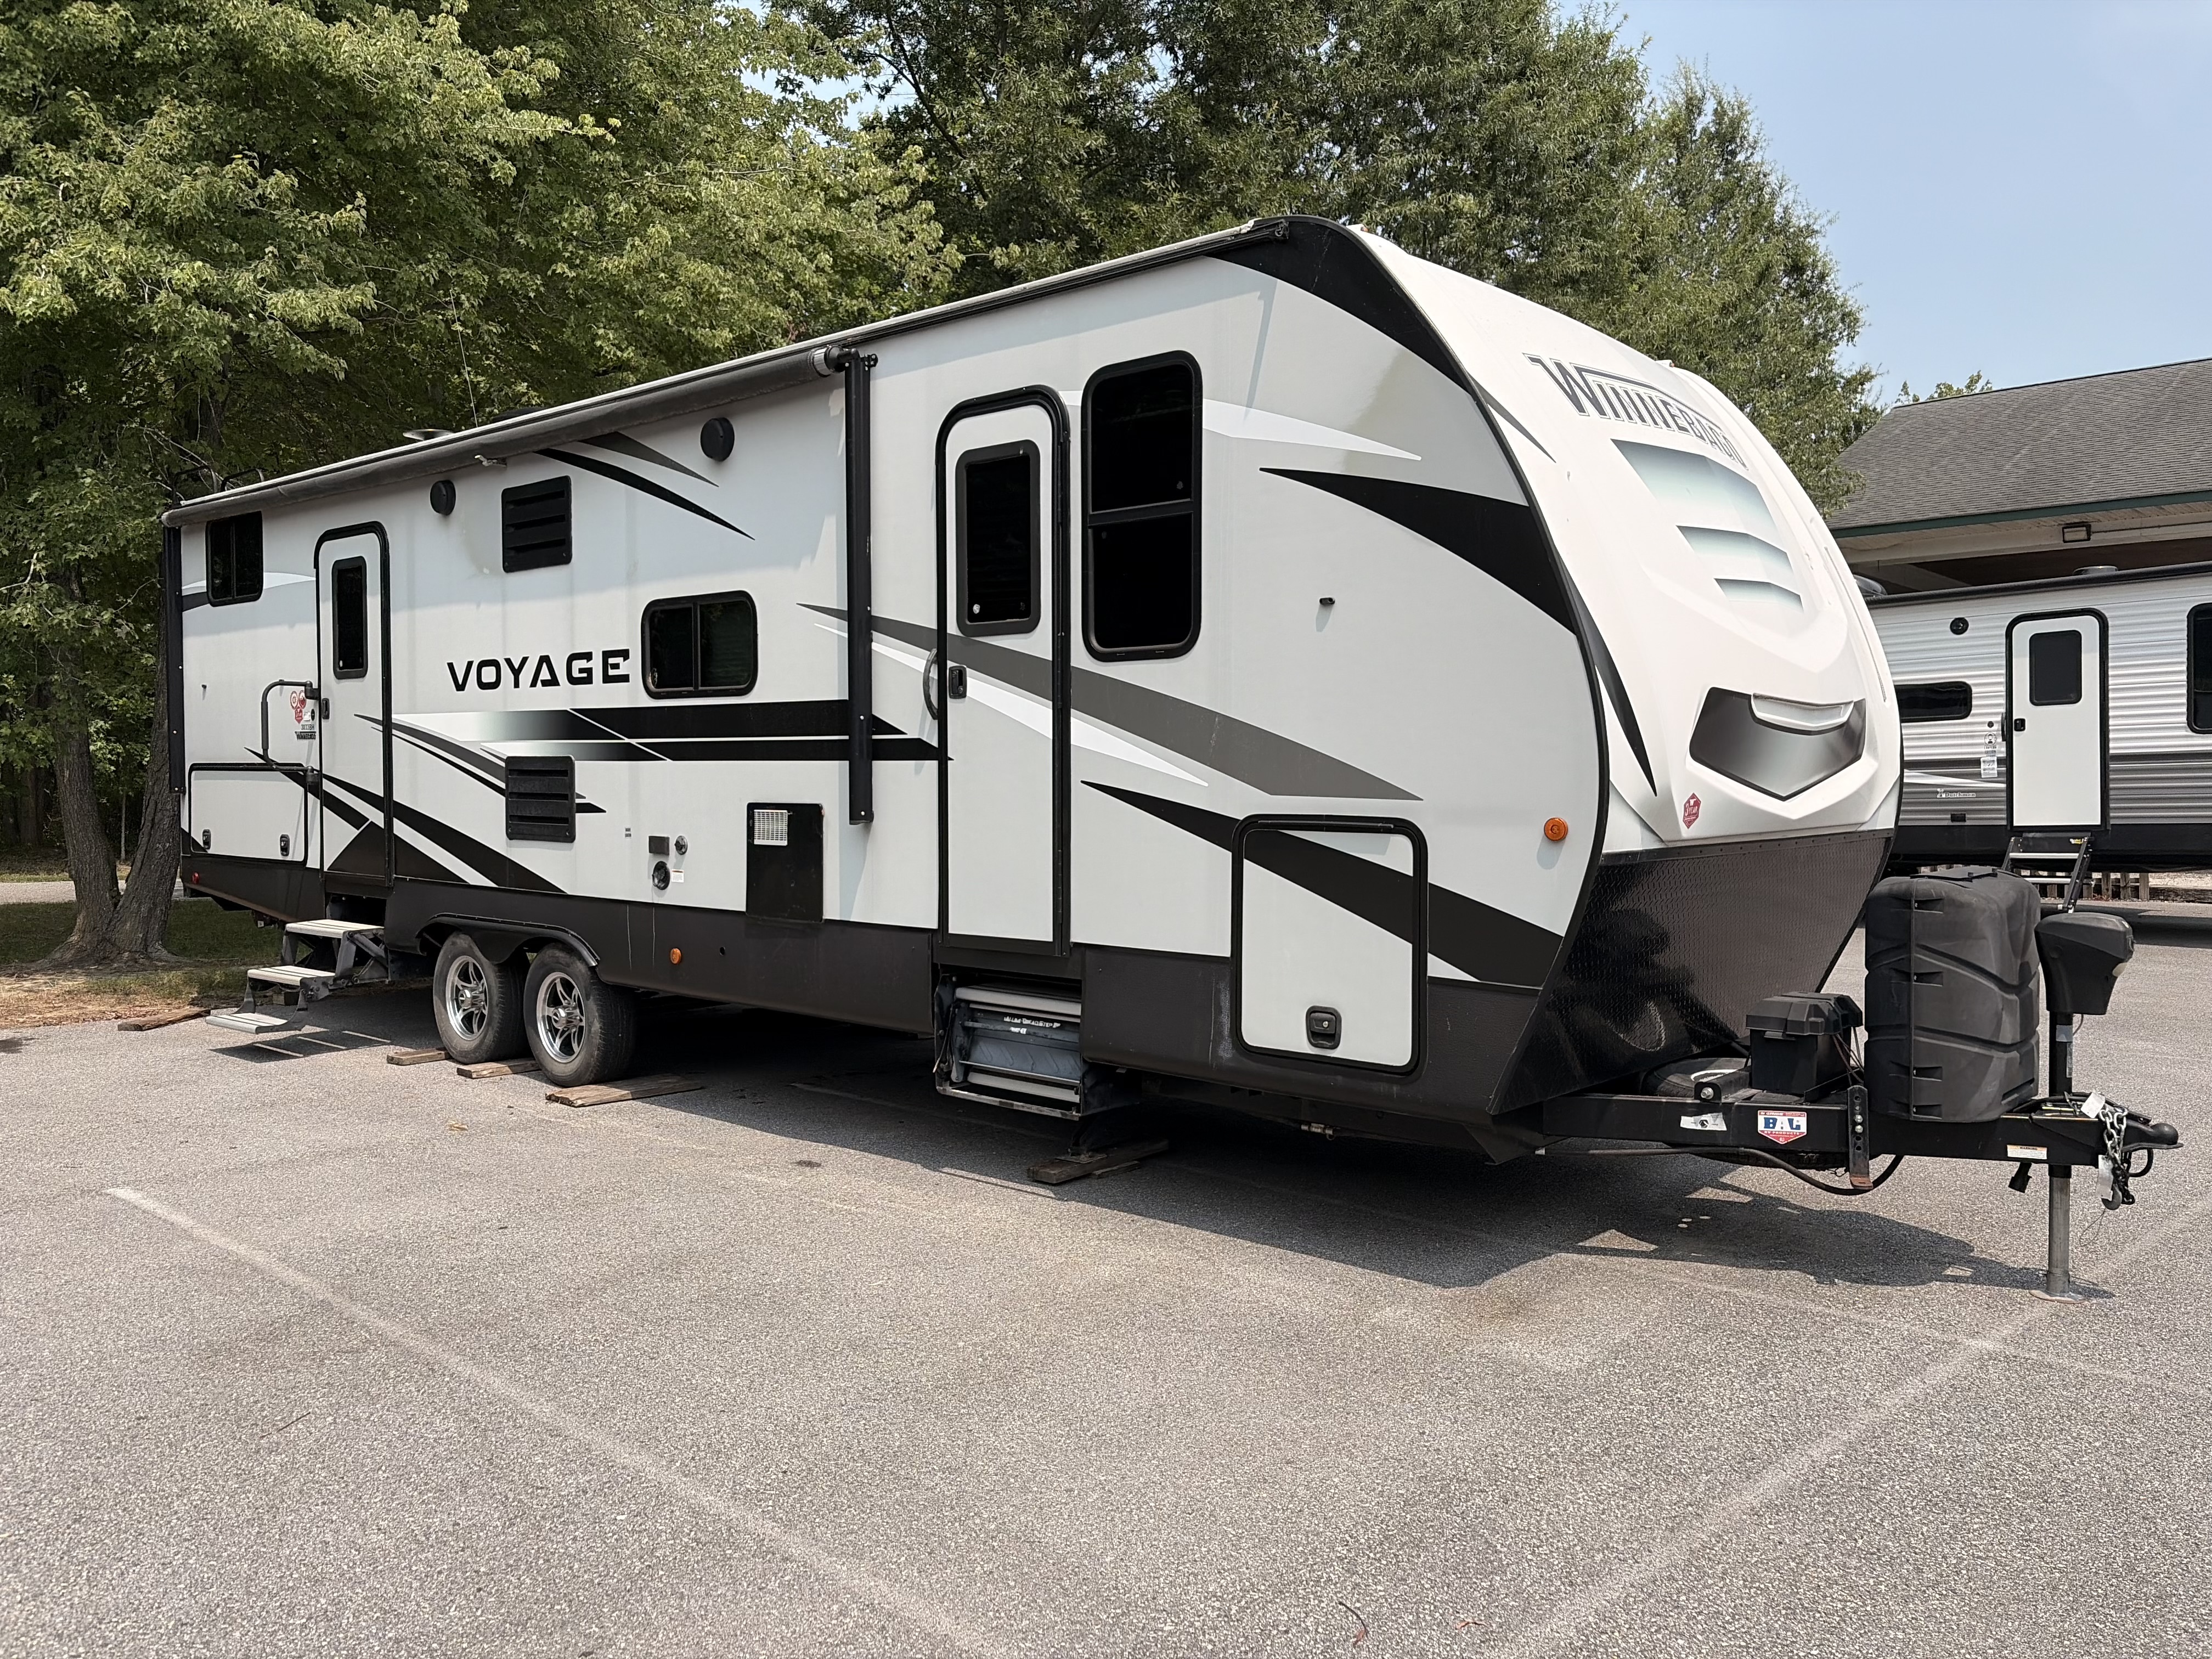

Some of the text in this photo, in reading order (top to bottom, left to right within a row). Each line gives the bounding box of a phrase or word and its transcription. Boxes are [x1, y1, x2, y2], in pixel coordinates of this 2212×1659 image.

[1521, 352, 1748, 471] WINNEBAGO
[446, 648, 630, 692] VOYAGE
[1764, 1116, 1801, 1130] BAL
